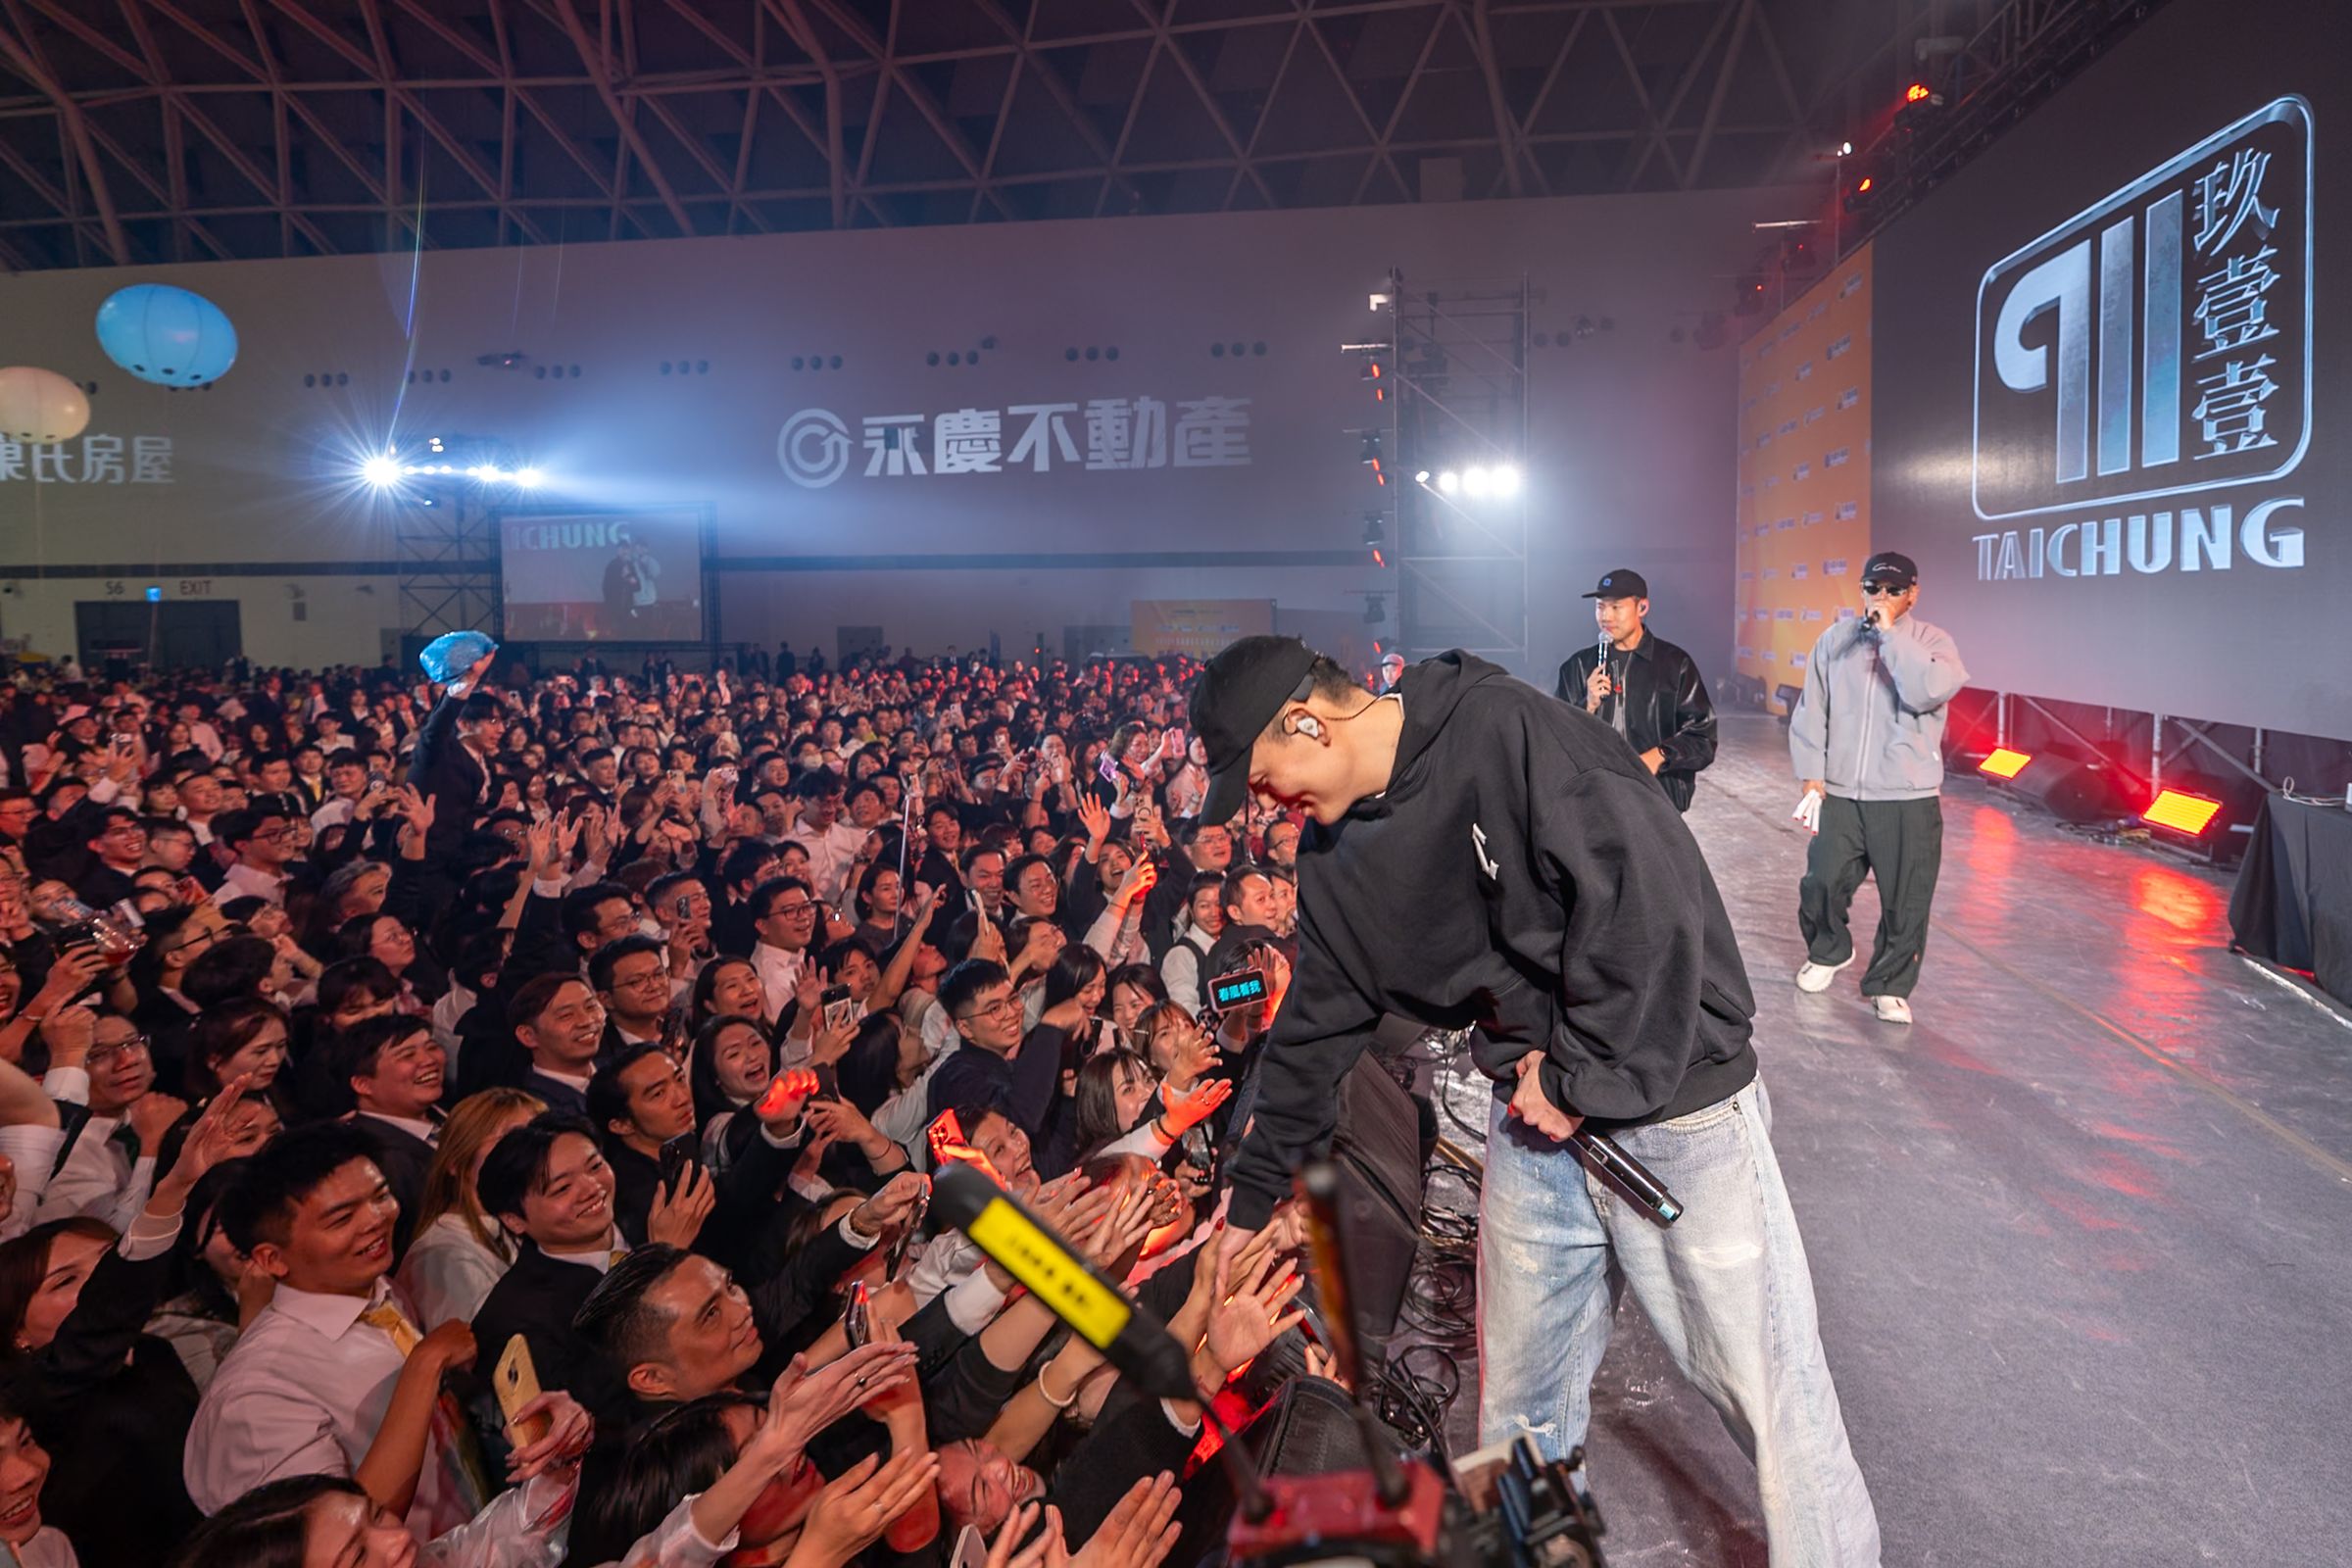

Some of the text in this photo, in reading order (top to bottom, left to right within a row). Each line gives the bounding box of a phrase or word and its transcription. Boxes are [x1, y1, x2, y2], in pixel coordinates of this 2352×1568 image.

[2191, 147, 2280, 461] 玖壹壹
[862, 395, 1252, 477] 永慶不動產
[1972, 497, 2306, 581] TAICHUNG
[179, 579, 213, 596] EXIT
